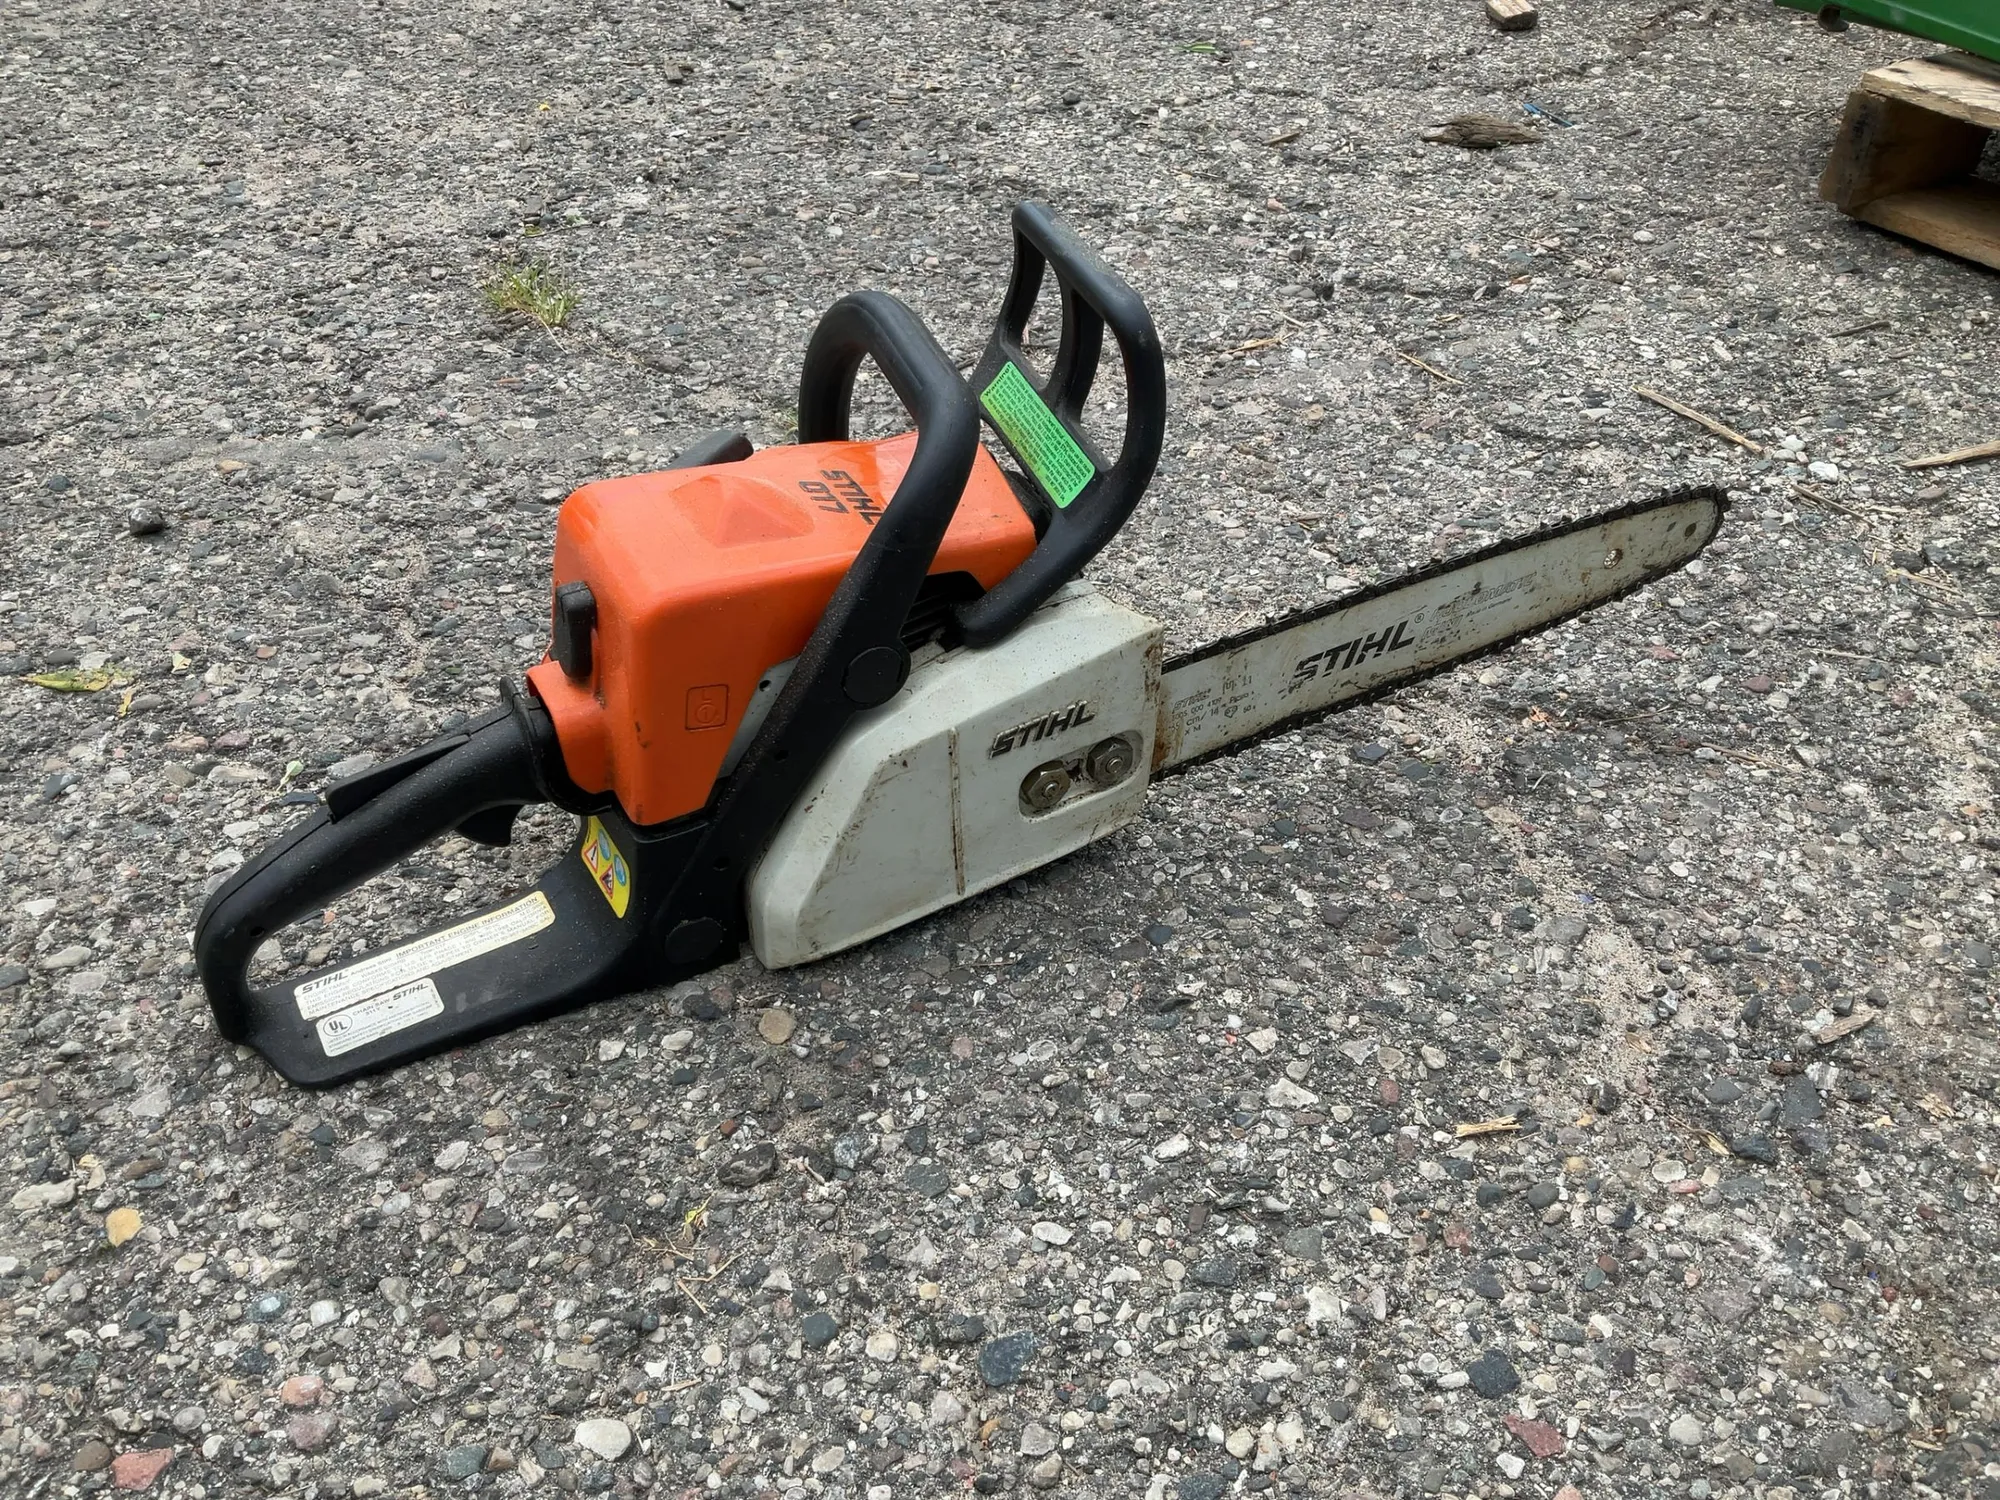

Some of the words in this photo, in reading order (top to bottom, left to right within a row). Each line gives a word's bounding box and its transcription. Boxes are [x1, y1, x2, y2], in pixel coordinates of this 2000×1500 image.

[984, 364, 1011, 397] Warning!
[820, 470, 884, 525] STIHL
[988, 700, 1096, 760] STIHL
[302, 972, 349, 994] STIHL
[396, 936, 444, 958] IMPORTANT
[448, 923, 478, 938] ENGINE
[481, 898, 538, 925] INFORMATION
[352, 1005, 375, 1016] CHAIN
[375, 999, 390, 1007] SAW
[392, 983, 428, 1001] STIHL
